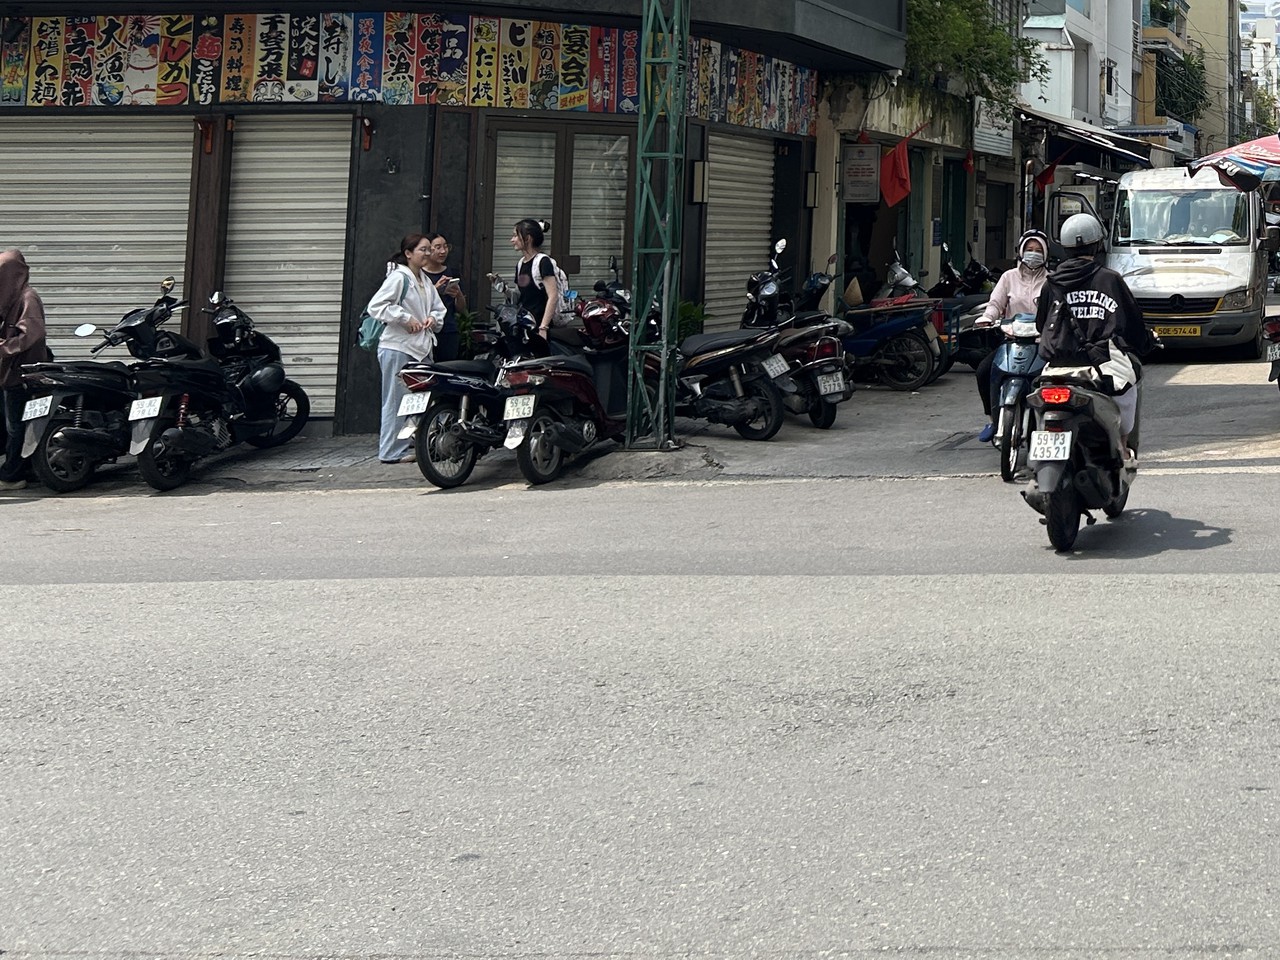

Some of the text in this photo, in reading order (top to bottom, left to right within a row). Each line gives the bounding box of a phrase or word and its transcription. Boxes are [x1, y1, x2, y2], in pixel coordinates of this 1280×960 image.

[1070, 306, 1106, 320] TELIER
[1037, 433, 1066, 445] 59-P3
[1032, 446, 1067, 458] 435.21
